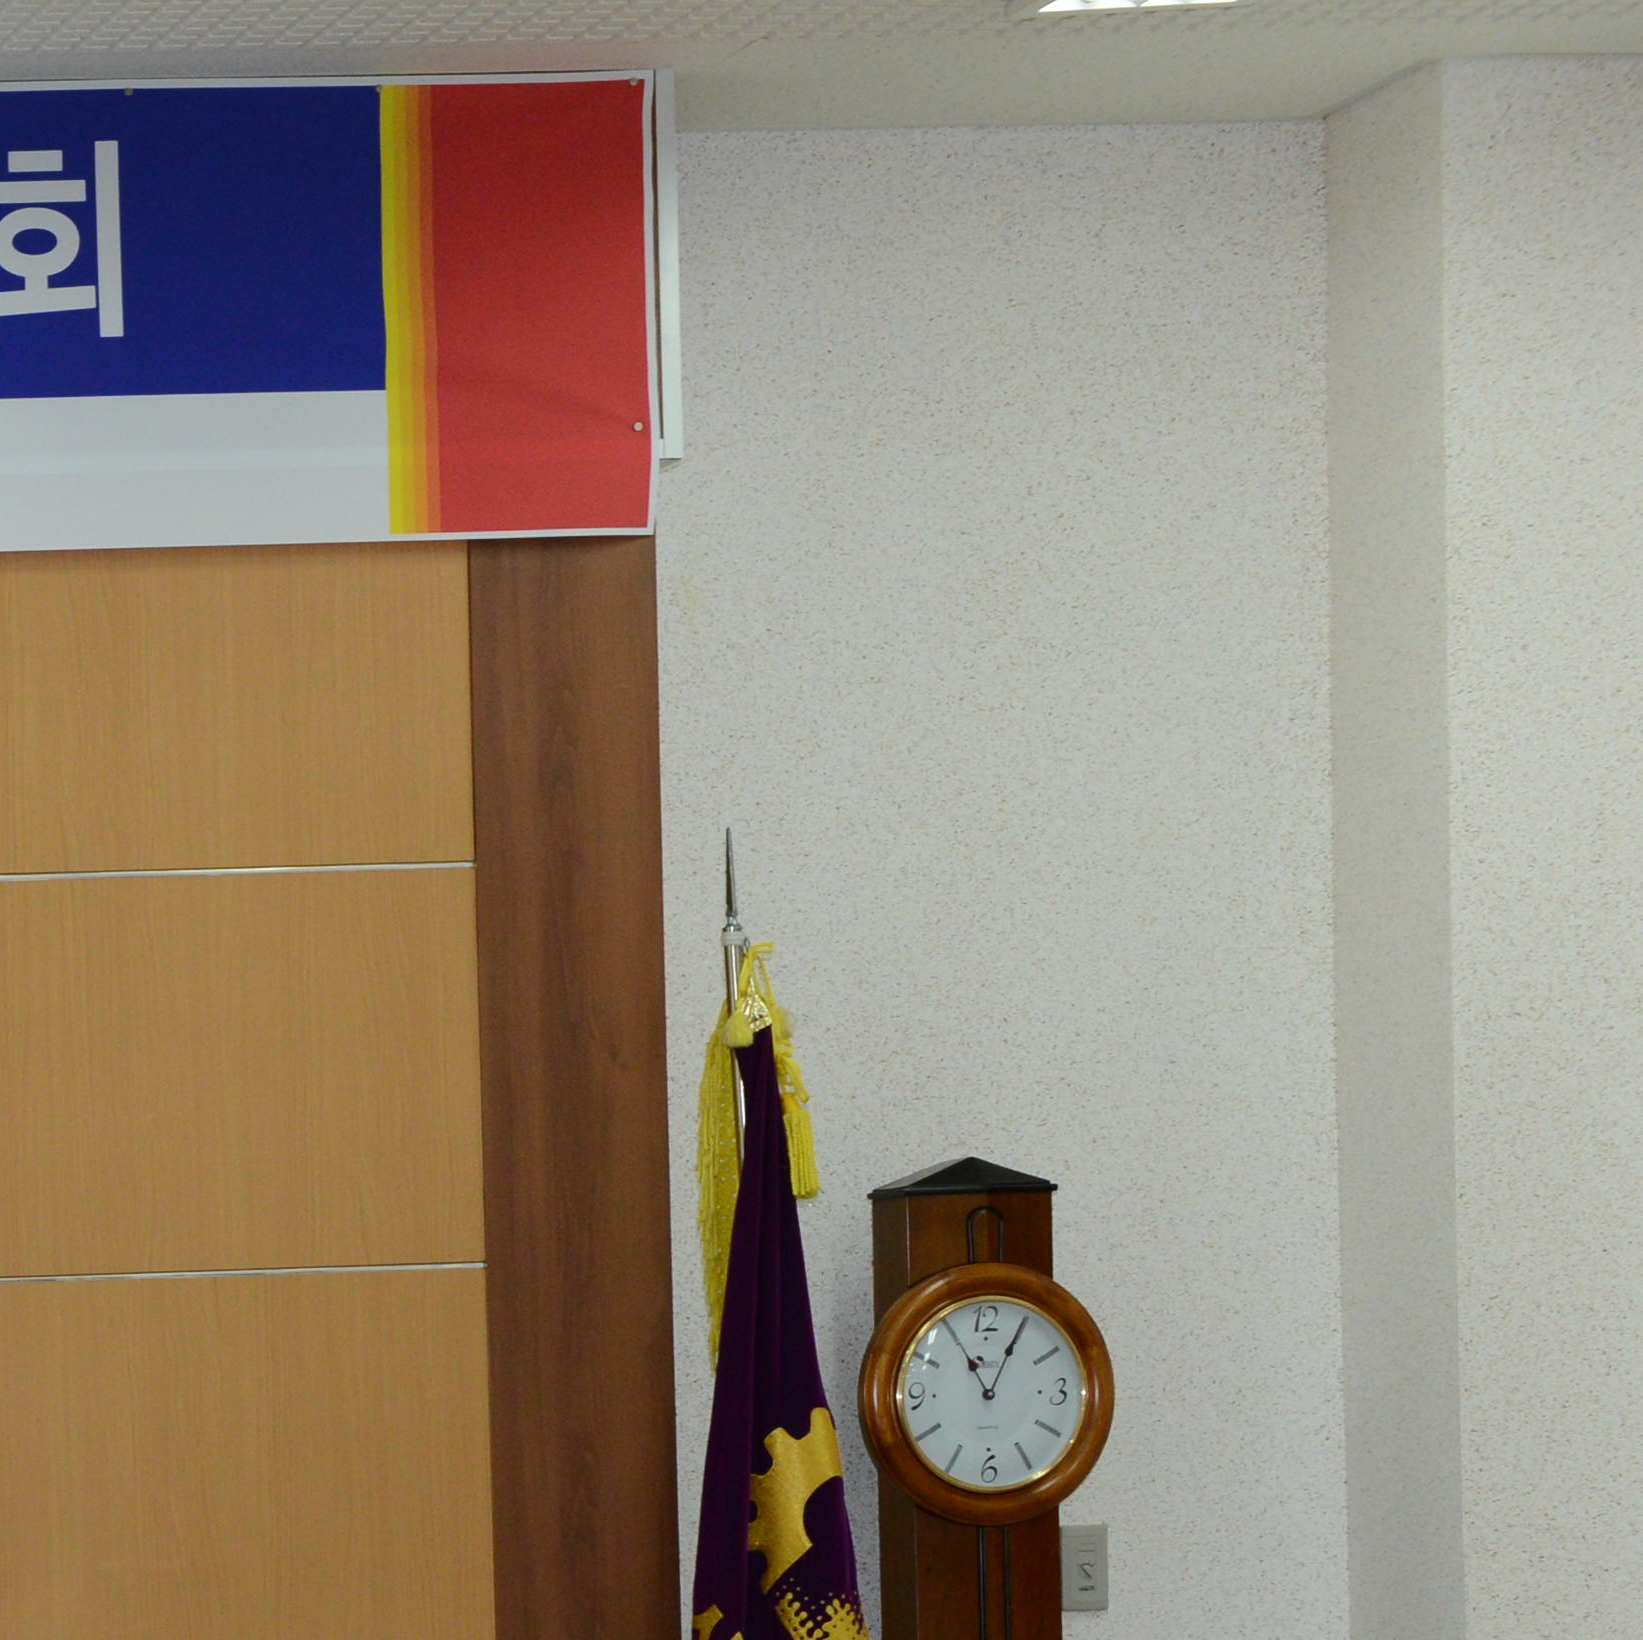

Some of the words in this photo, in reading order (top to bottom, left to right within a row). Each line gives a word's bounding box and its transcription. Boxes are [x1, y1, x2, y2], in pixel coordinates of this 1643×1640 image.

[972, 1305, 999, 1333] 12
[908, 1382, 925, 1411] 9
[1049, 1377, 1068, 1406] 3
[980, 1454, 998, 1483] 6
